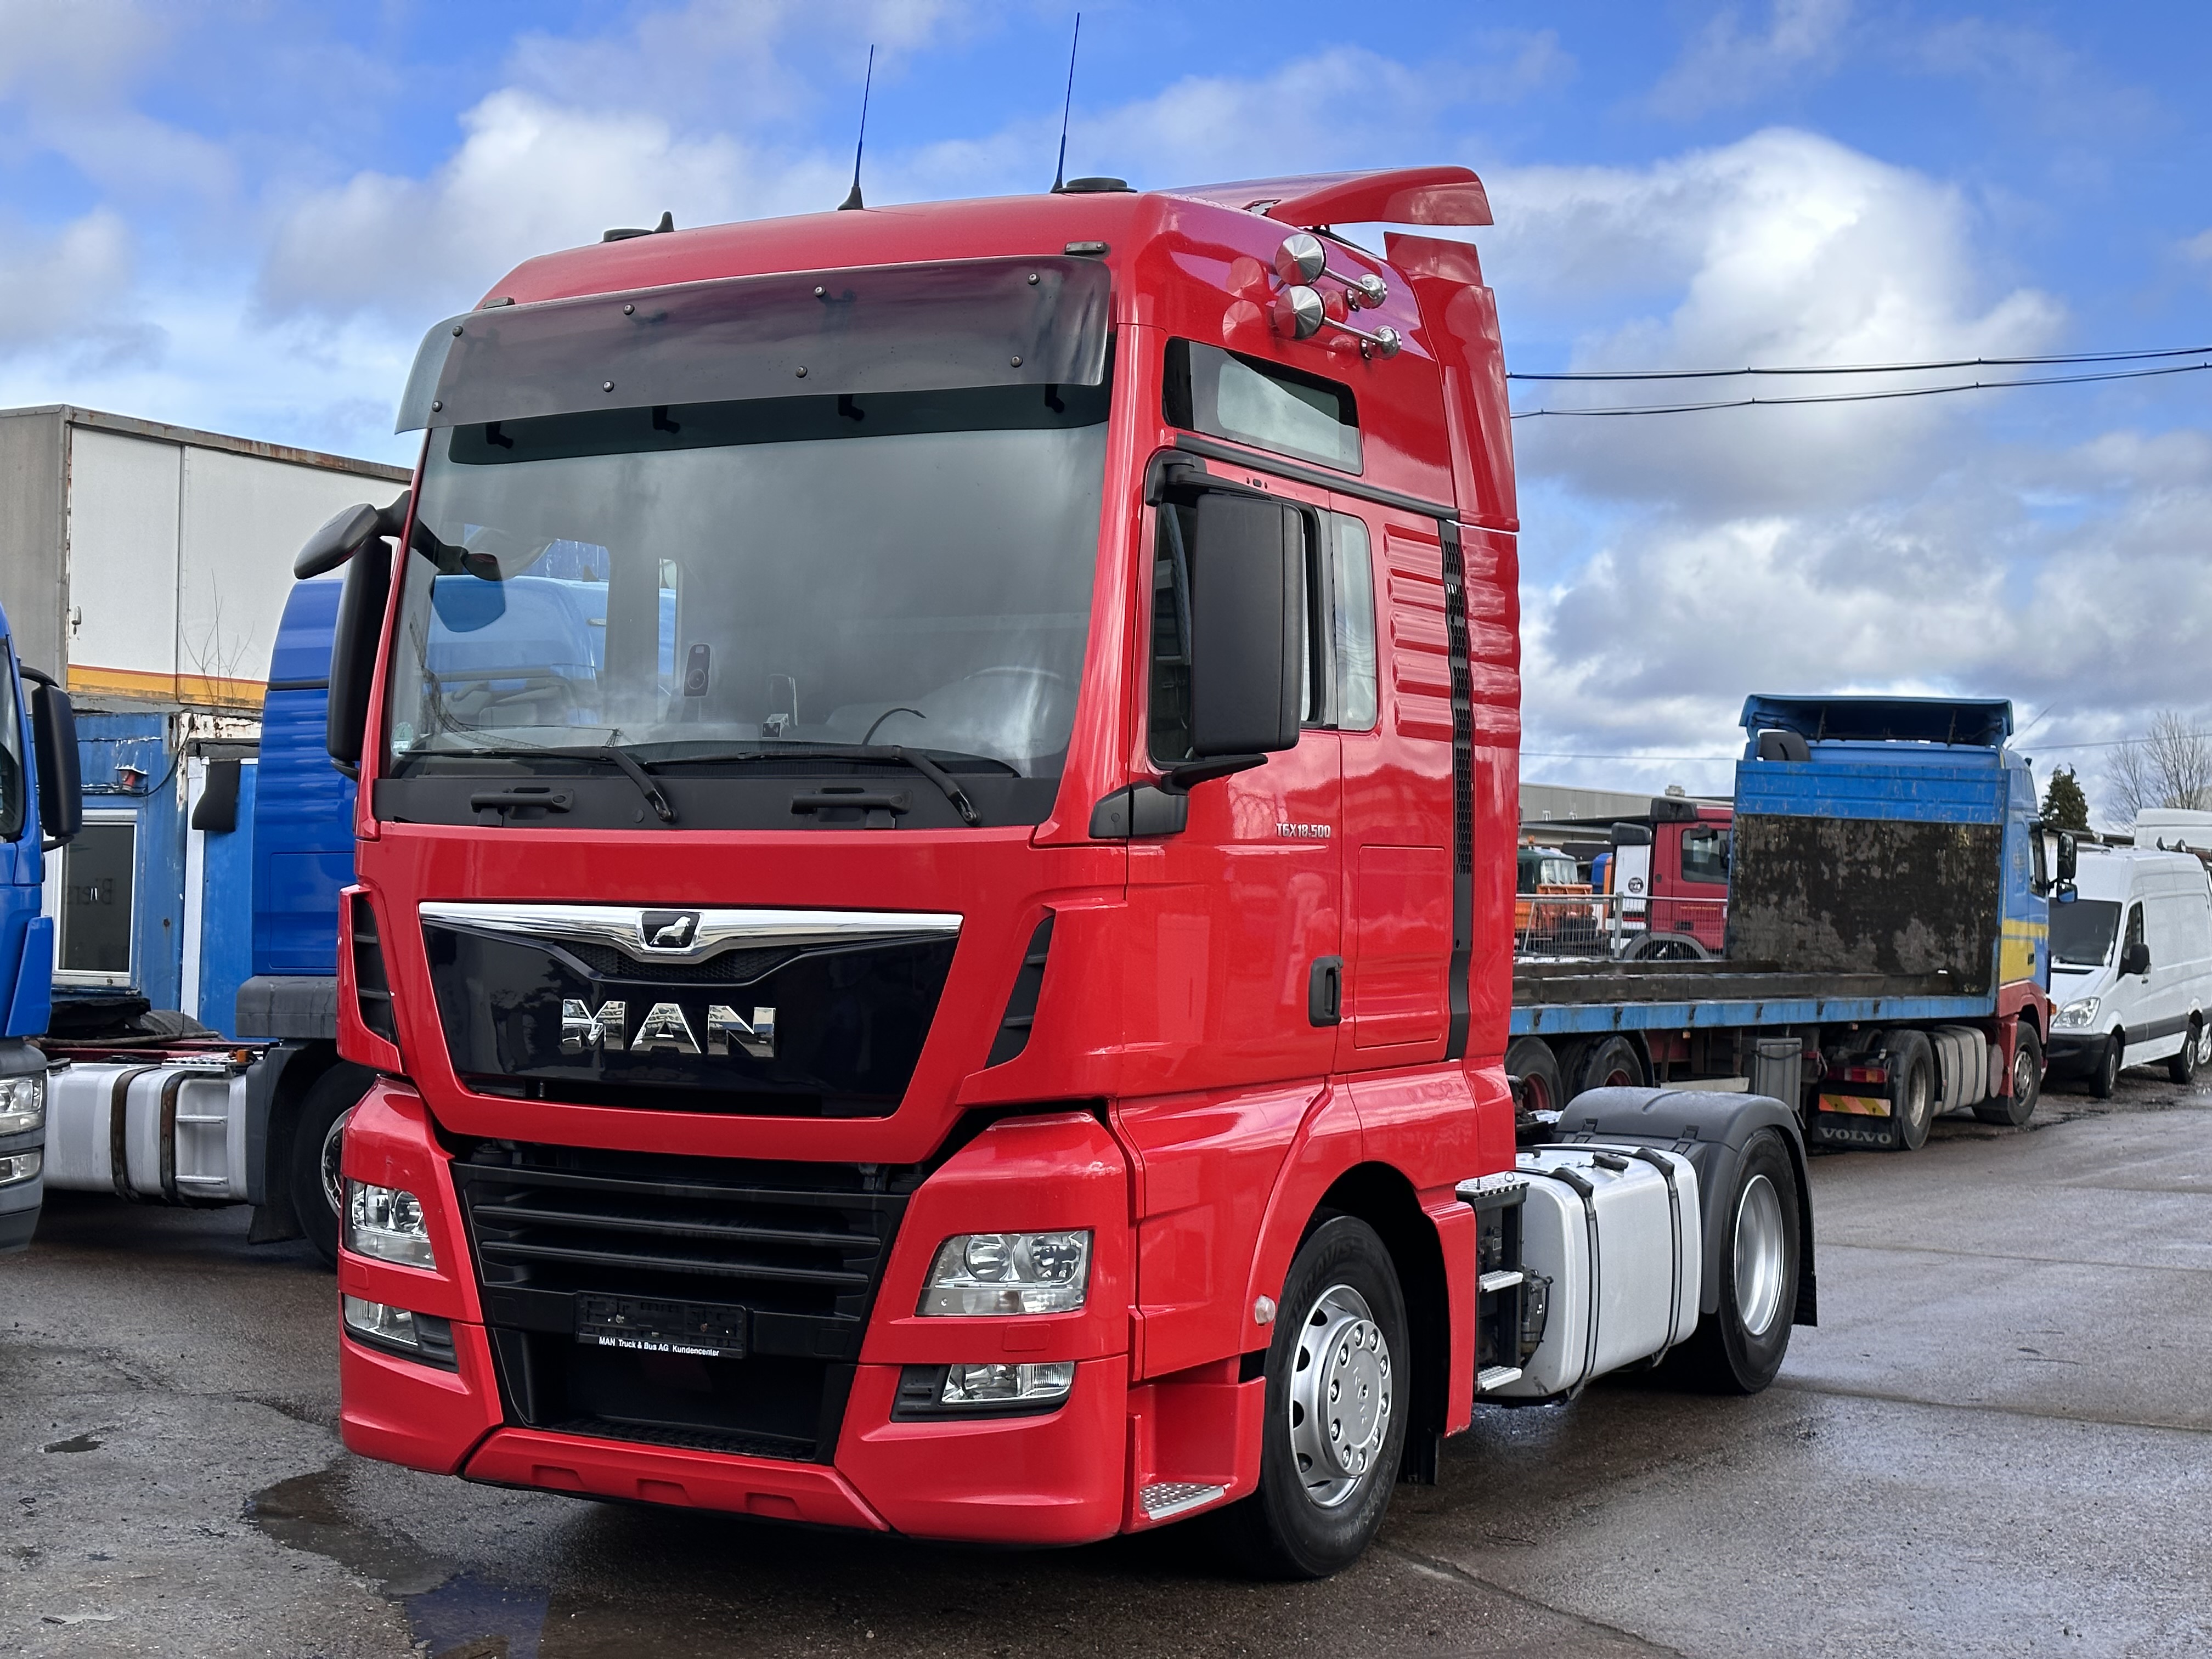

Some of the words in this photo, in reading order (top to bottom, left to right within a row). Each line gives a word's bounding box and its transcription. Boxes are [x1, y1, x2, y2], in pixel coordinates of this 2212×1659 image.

[562, 998, 776, 1058] MAN
[1818, 1127, 1892, 1144] VOLVO
[599, 1336, 616, 1346] MAN
[618, 1339, 636, 1348] Truck
[637, 1341, 642, 1349] &
[644, 1342, 657, 1351] Bus
[658, 1344, 669, 1352] AG
[672, 1345, 720, 1357] Kundencenter
